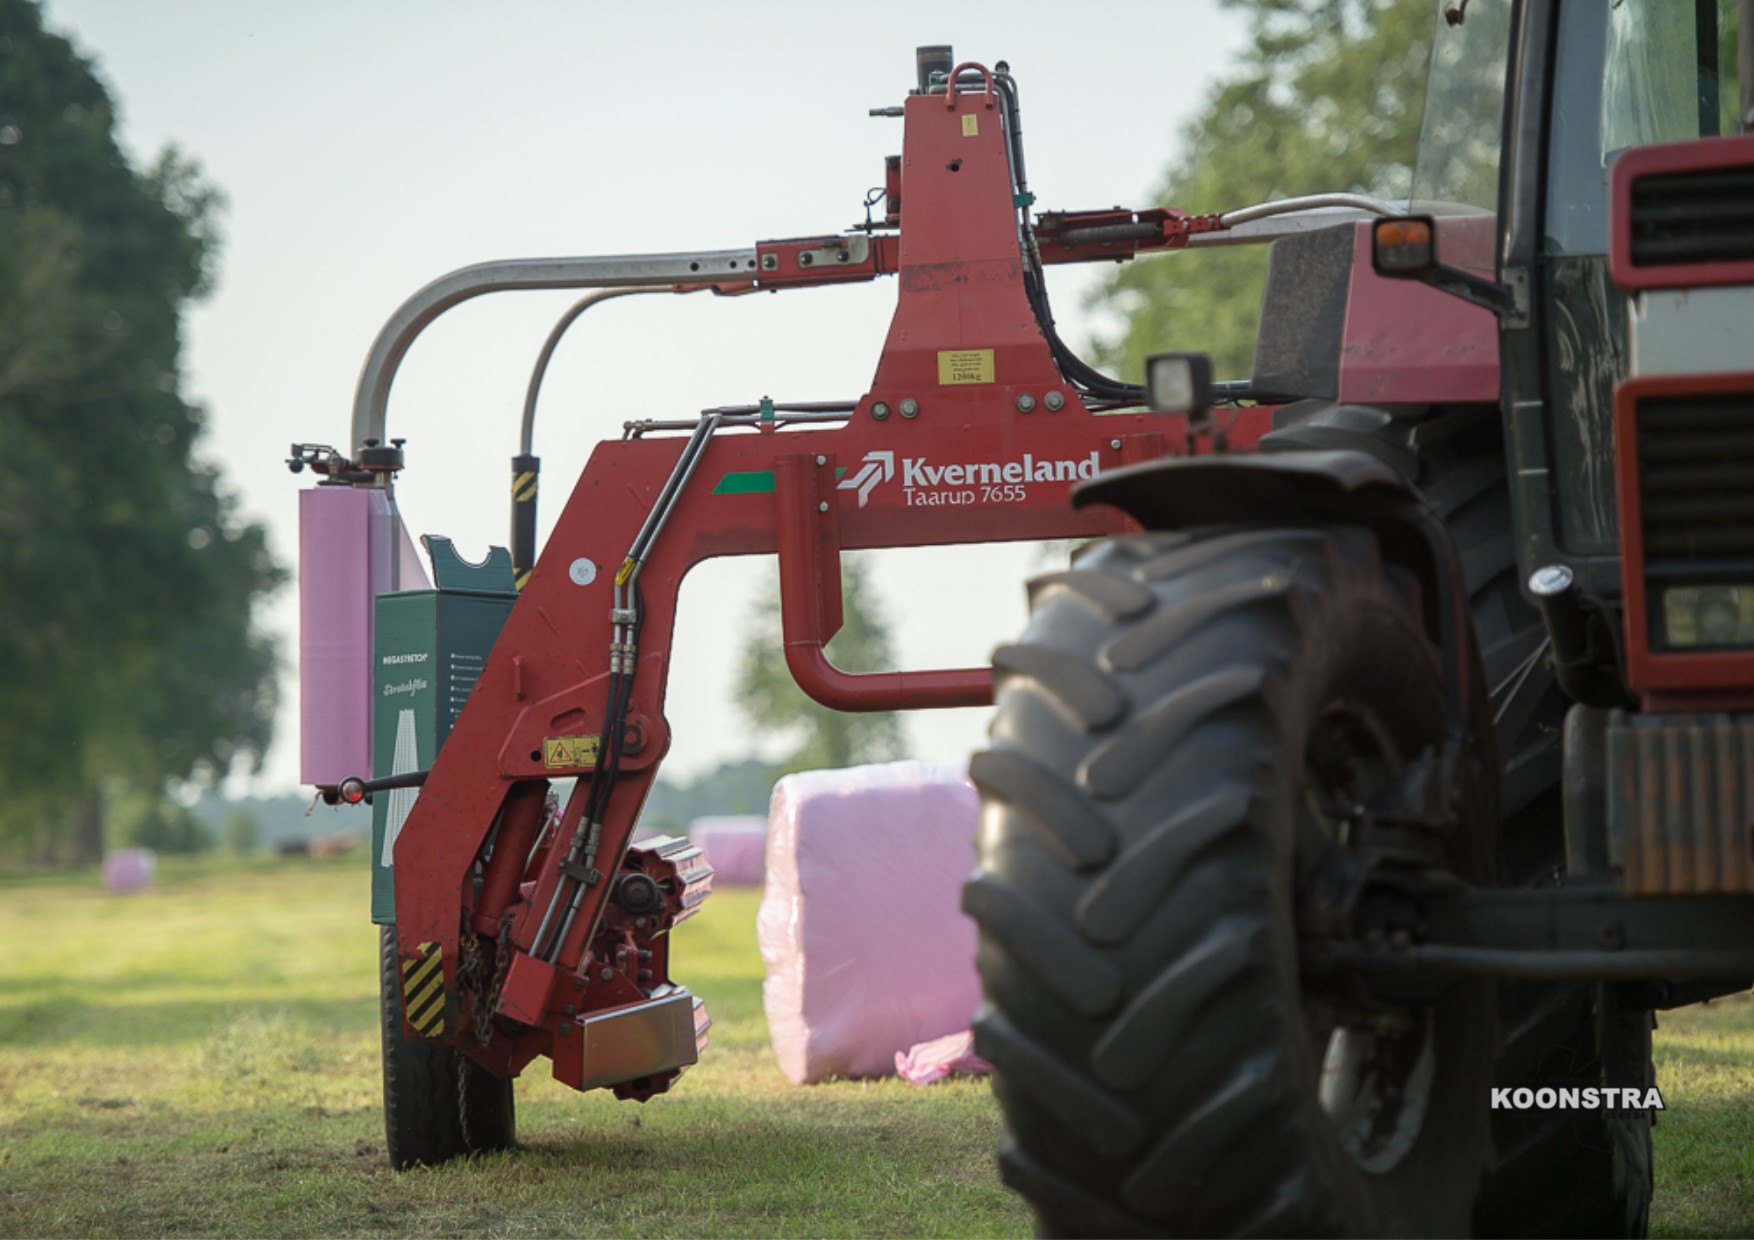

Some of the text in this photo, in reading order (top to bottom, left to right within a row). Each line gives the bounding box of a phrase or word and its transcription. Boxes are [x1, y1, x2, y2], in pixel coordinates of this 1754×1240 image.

[902, 451, 1101, 487] Kverneland
[903, 485, 1027, 506] Taarup 7655
